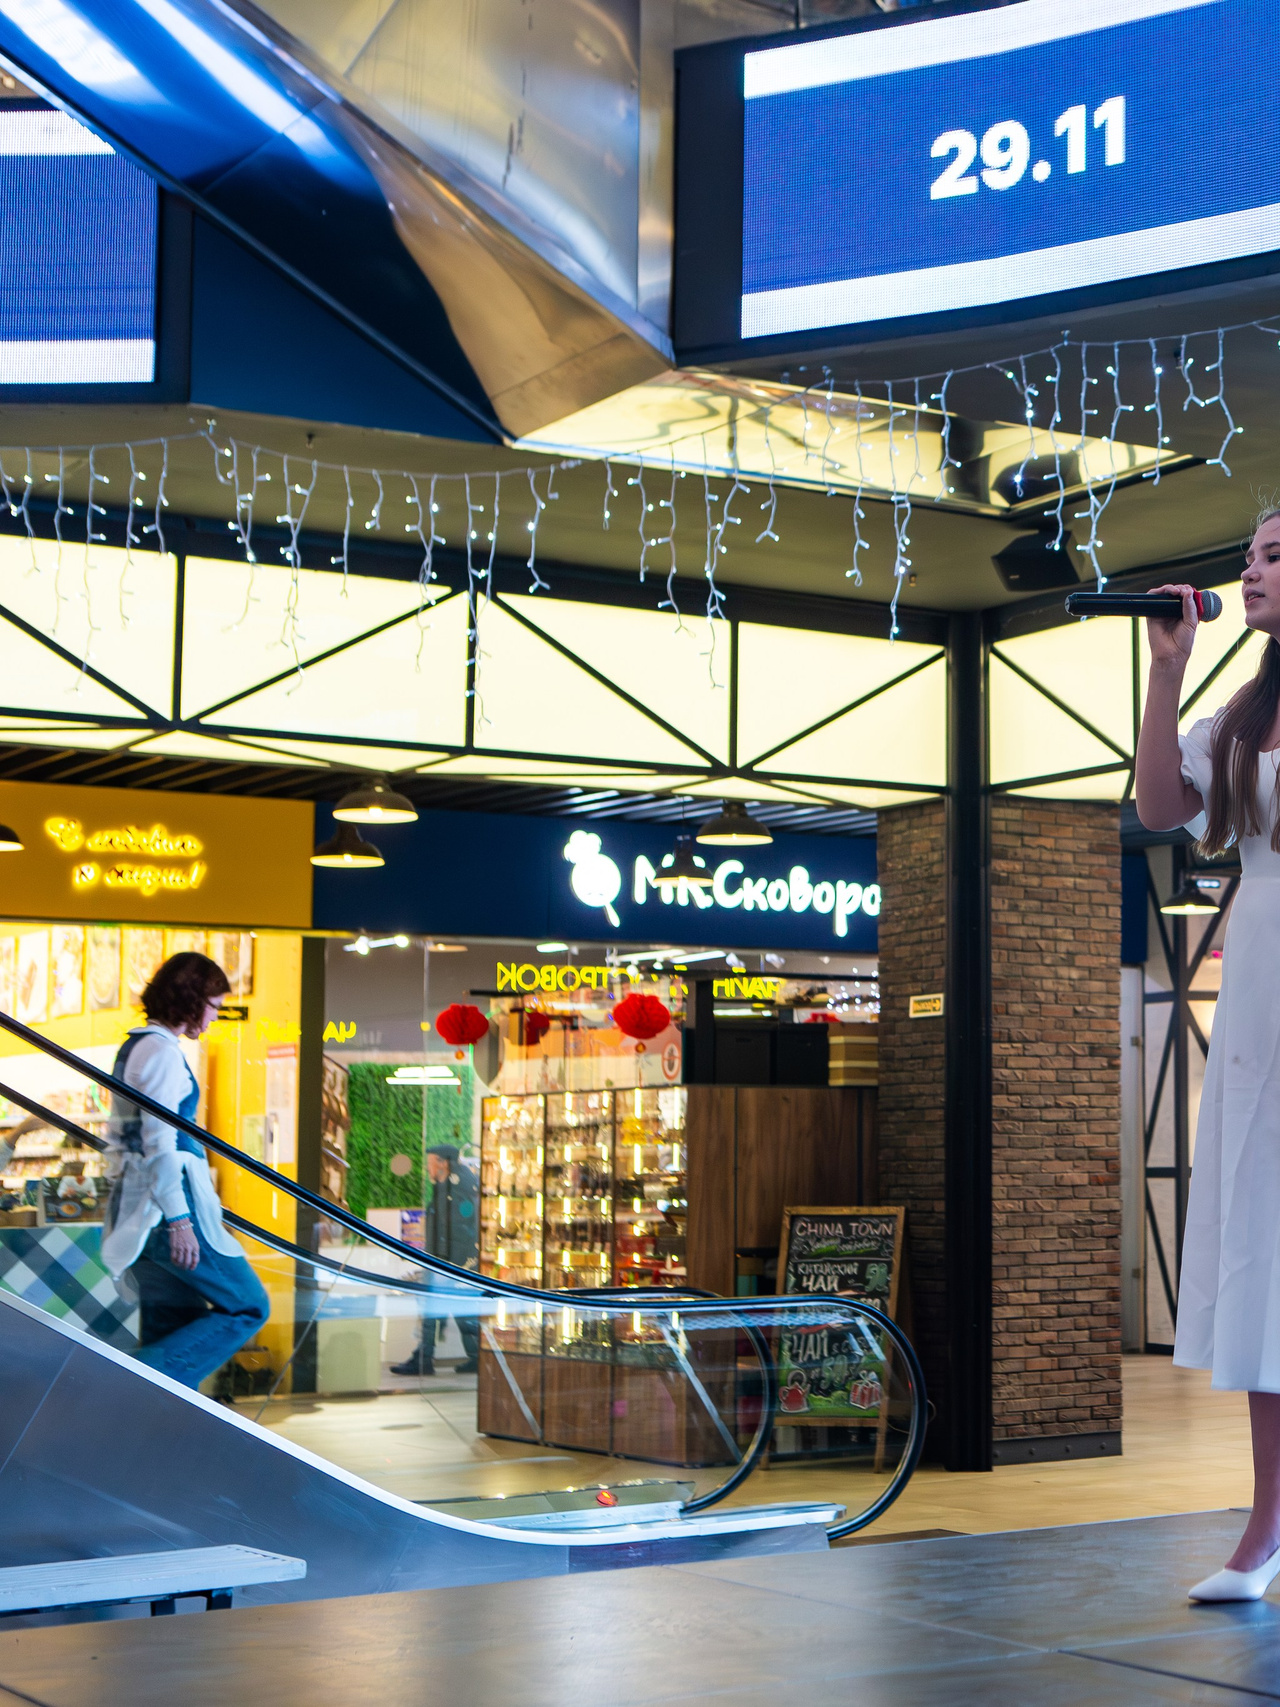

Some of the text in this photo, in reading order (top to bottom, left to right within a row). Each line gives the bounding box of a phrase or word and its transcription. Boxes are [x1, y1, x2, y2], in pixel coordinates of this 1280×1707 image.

[929, 95, 1126, 200] 29.11
[796, 1222, 893, 1236] CHINA TOWN
